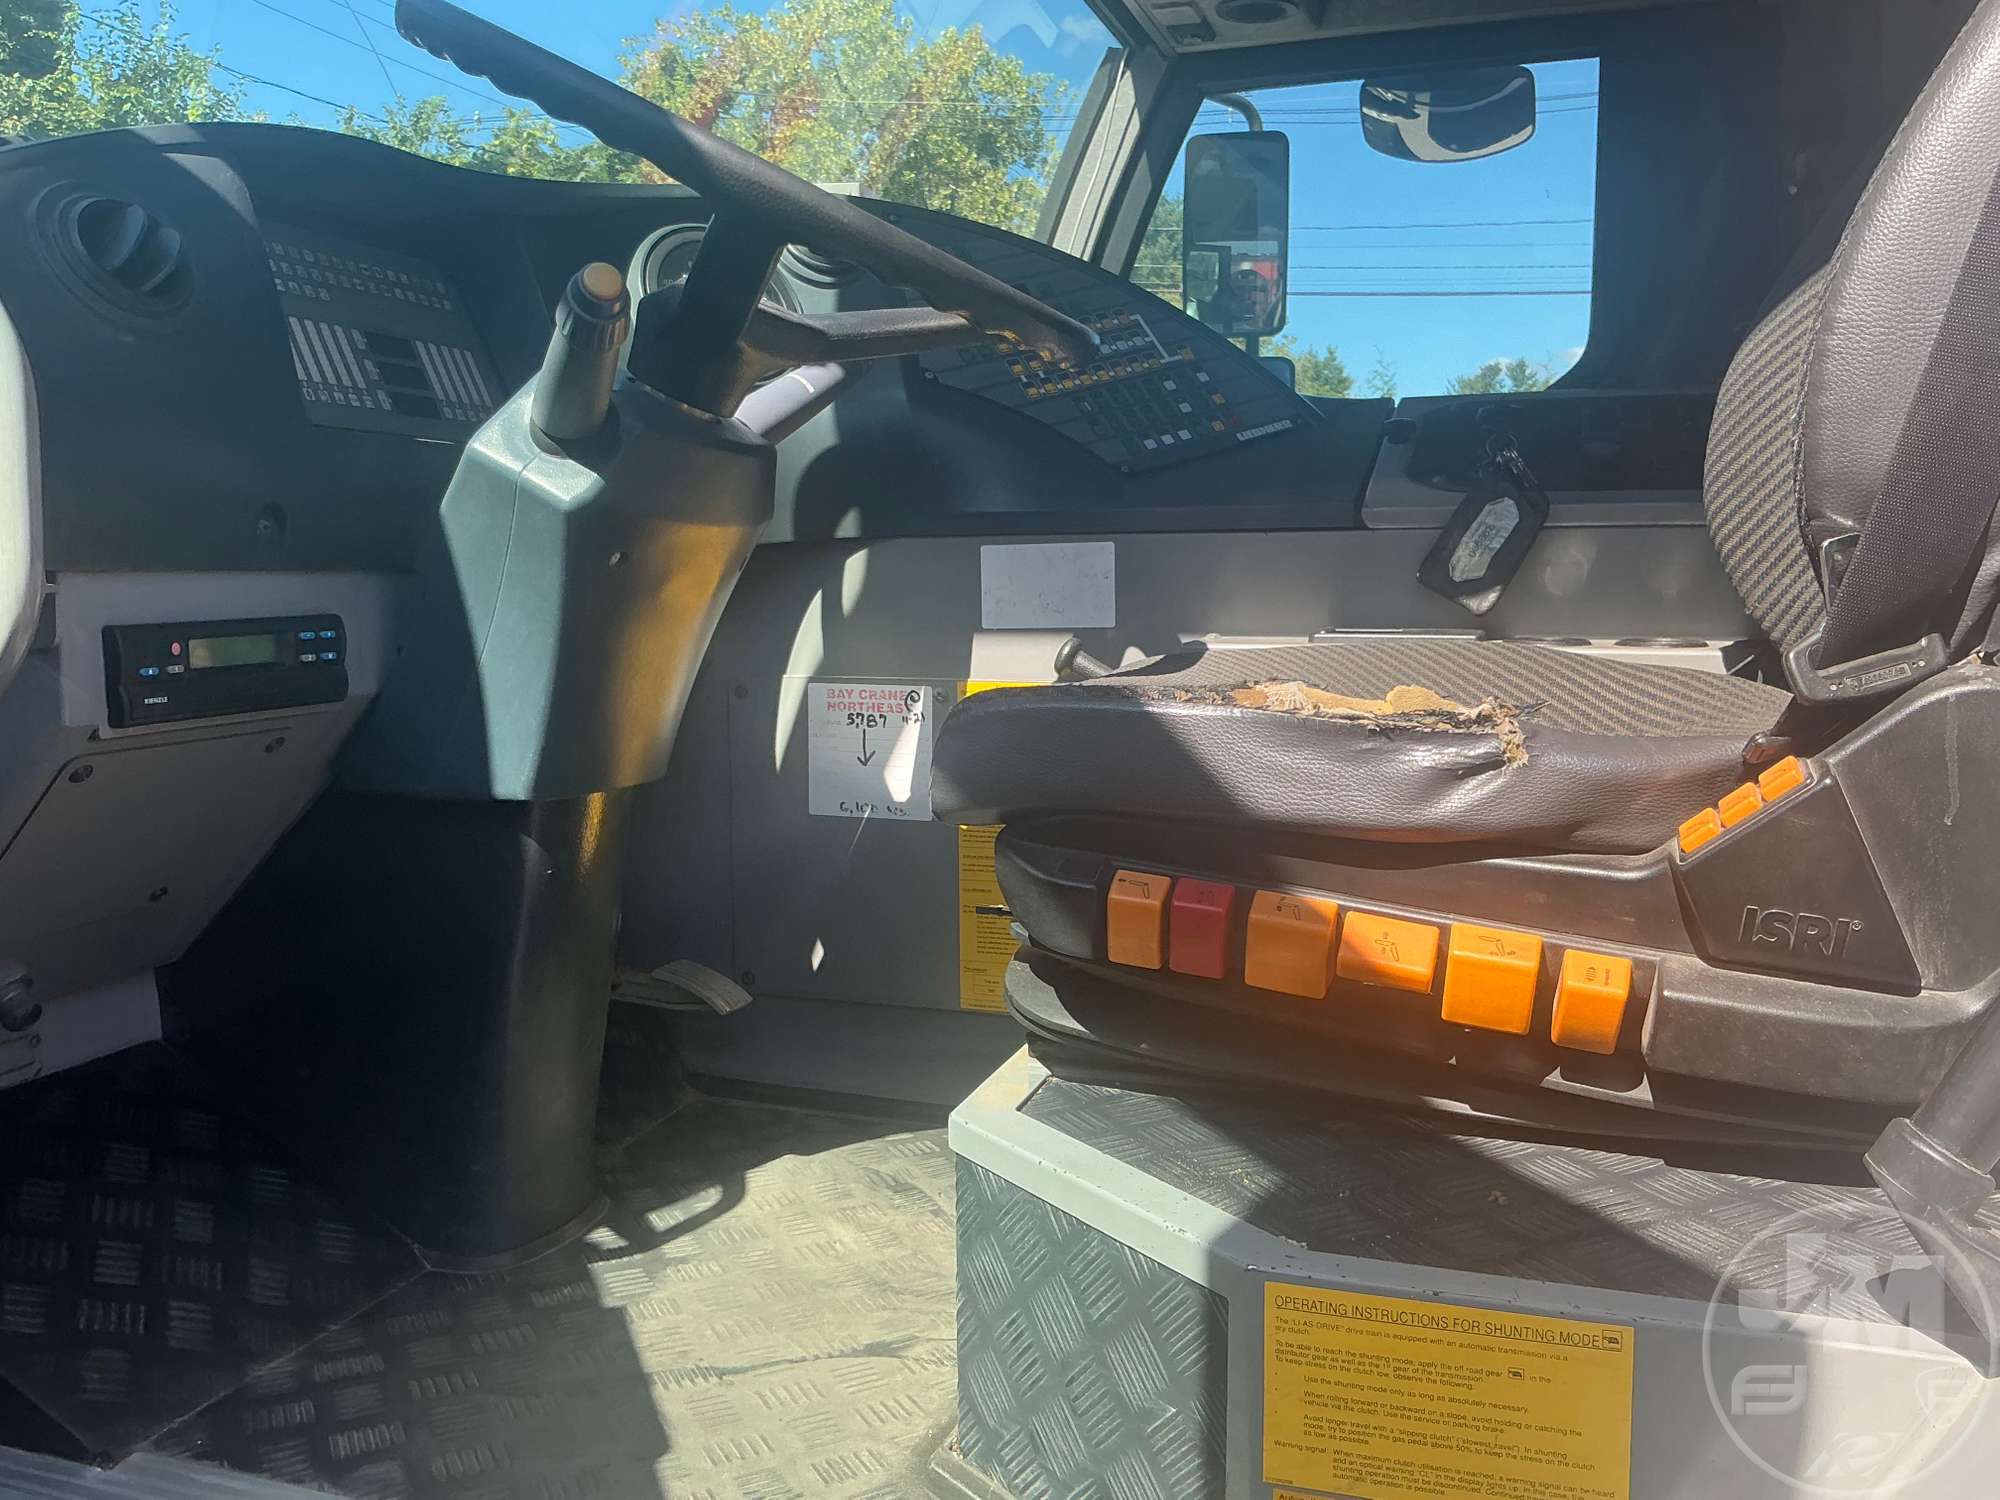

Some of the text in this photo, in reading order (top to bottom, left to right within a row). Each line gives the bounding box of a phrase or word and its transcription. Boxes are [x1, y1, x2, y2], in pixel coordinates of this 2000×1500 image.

[826, 688, 907, 702] BAY CRANE
[1274, 1294, 1347, 1315] OPERATING
[1351, 1304, 1448, 1328] INSTRUCTIONS
[1484, 1321, 1554, 1342] SHUNTING
[1559, 1331, 1600, 1348] MODE
[1345, 1325, 1363, 1334] drive
[1392, 1331, 1427, 1344] equipped
[1429, 1336, 1443, 1345] with
[1457, 1340, 1495, 1352] automatic
[1497, 1345, 1546, 1359] transmission
[1274, 1347, 1310, 1358] distributor
[1311, 1353, 1328, 1362] gear
[1340, 1356, 1356, 1365] well
[1393, 1365, 1409, 1373] gear
[1284, 1356, 1303, 1366] keep
[1304, 1359, 1326, 1368] stress
[1352, 1365, 1373, 1375] clutch
[1393, 1371, 1422, 1382] observe
[1295, 1342, 1311, 1350] able
[1322, 1346, 1342, 1355] reach
[1358, 1350, 1390, 1363] shunting
[1417, 1359, 1437, 1369] apply
[1484, 1369, 1502, 1378] gear
[1333, 1380, 1364, 1391] shunting
[1366, 1384, 1387, 1393] mode
[1389, 1388, 1404, 1397] only
[1418, 1392, 1434, 1401] long
[1447, 1396, 1486, 1409] absolutely
[1303, 1390, 1324, 1399] When
[1326, 1394, 1348, 1403] rolling
[1350, 1397, 1378, 1406] forward
[1389, 1403, 1425, 1414] backward
[1534, 1424, 1567, 1436] catching
[1303, 1397, 1328, 1407] vehicle
[1413, 1414, 1440, 1424] service
[1452, 1420, 1480, 1432] parking
[1303, 1413, 1323, 1422] Avoid
[1326, 1416, 1347, 1427] longer
[1350, 1420, 1370, 1429] travel
[1372, 1424, 1387, 1432] with
[1533, 1448, 1567, 1460] shunting
[1348, 1428, 1376, 1439] position
[1407, 1437, 1428, 1447] pedal
[1430, 1440, 1453, 1450] above
[1484, 1449, 1503, 1459] keep
[1519, 1454, 1543, 1463] stress
[1571, 1462, 1595, 1471] clutch
[1273, 1438, 1302, 1450] Warning
[1332, 1448, 1354, 1458] When
[1355, 1452, 1391, 1464] maximum
[1393, 1458, 1415, 1467] clutch
[1505, 1475, 1536, 1488] warning
[1537, 1480, 1561, 1492] signal
[1591, 1489, 1615, 1499] heard
[1332, 1464, 1362, 1475] shunting
[1364, 1469, 1399, 1481] operation
[1401, 1475, 1417, 1483] must
[1332, 1471, 1367, 1483] automatic
[1369, 1477, 1404, 1490] operation
[1358, 1460, 1383, 1471] optical
[1385, 1464, 1414, 1476] warning
[1457, 1476, 1483, 1487] display
